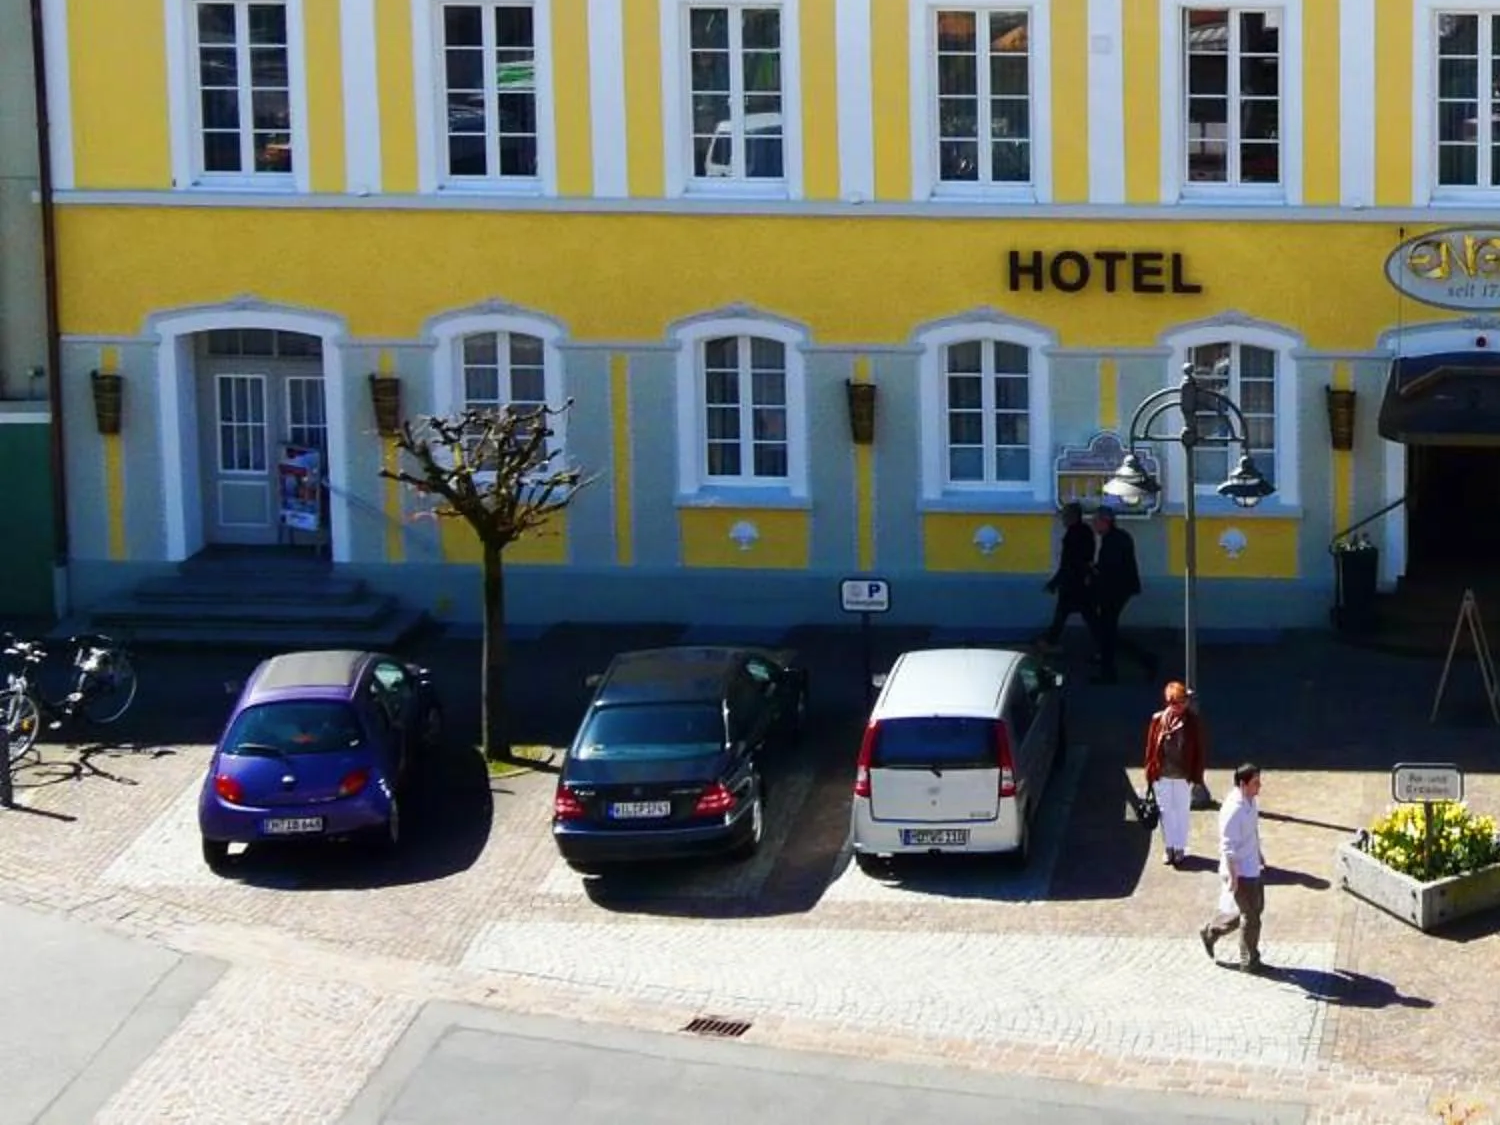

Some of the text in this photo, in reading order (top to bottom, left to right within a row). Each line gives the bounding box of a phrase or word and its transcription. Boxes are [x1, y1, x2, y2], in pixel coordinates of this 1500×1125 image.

[1009, 250, 1203, 293] HOTEL
[1447, 283, 1475, 299] seit
[868, 582, 881, 598] P
